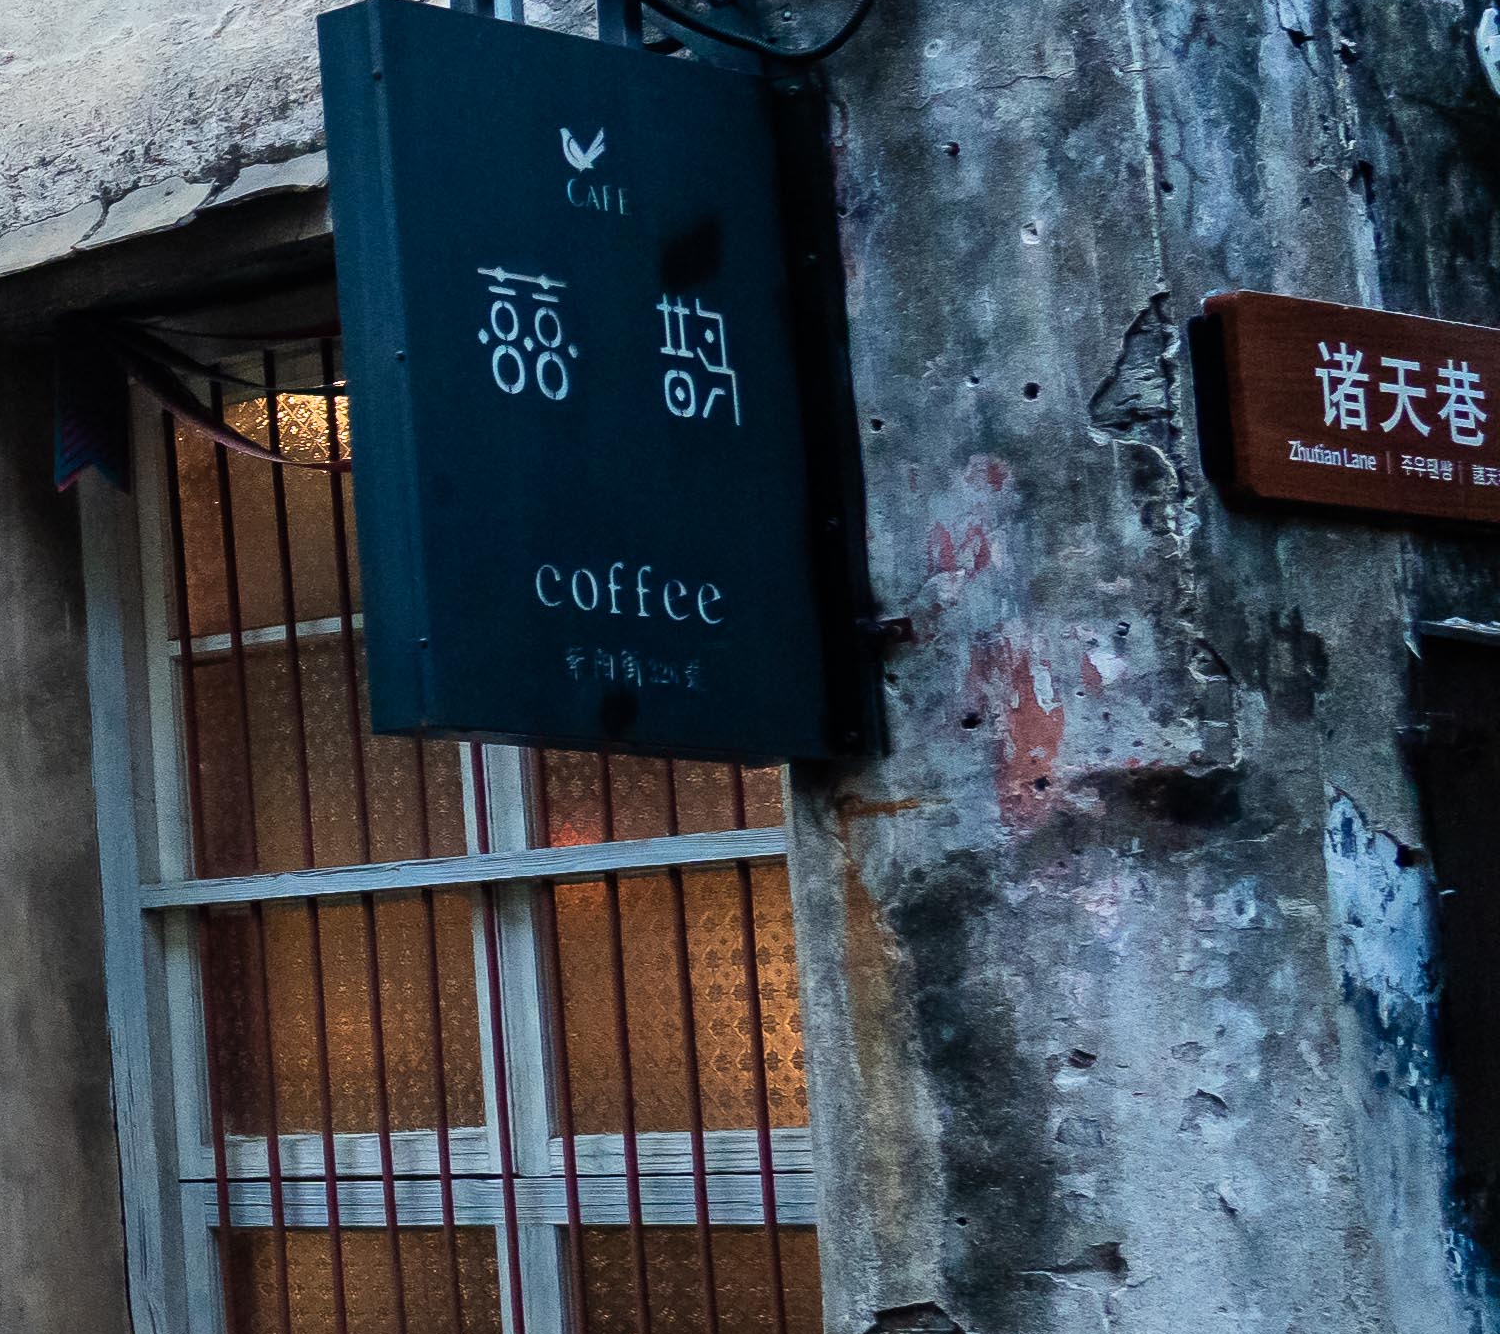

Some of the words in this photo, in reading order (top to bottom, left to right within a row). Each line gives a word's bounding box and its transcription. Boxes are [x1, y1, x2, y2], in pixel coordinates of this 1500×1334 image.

[565, 178, 632, 217] CAFE
[1315, 341, 1488, 447] 诸天巷
[1287, 440, 1341, 466] Zhutian
[1343, 447, 1377, 470] Lane
[534, 560, 726, 627] coffee
